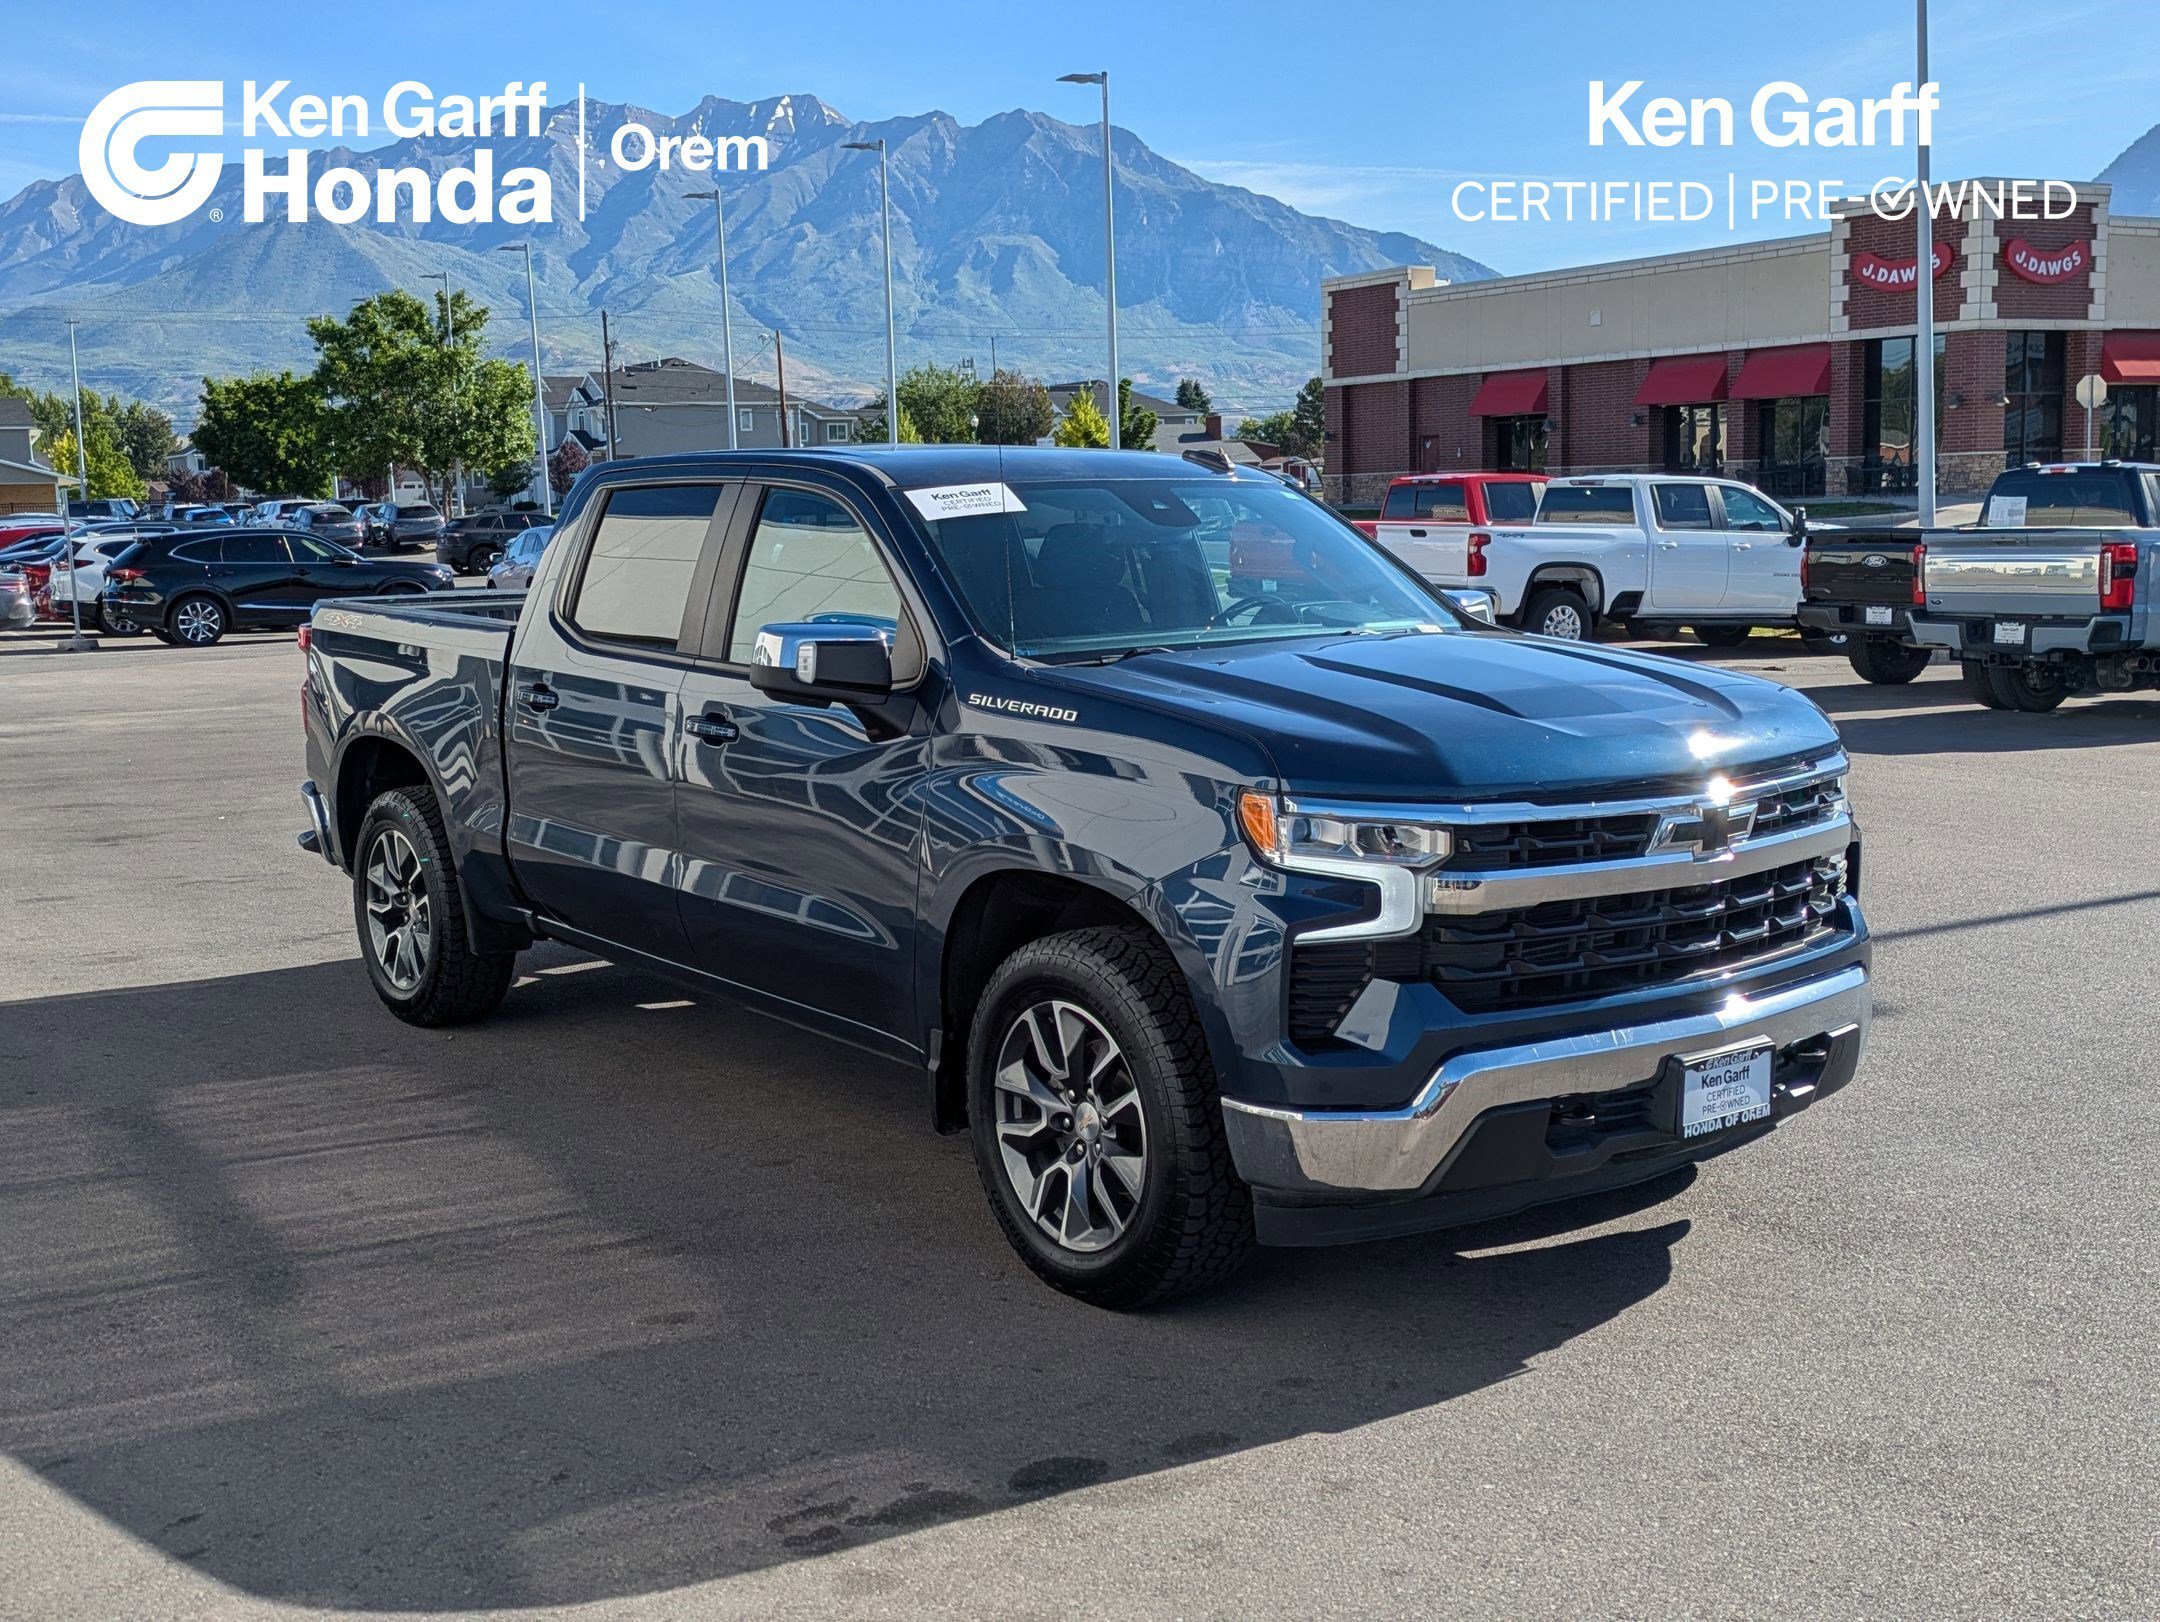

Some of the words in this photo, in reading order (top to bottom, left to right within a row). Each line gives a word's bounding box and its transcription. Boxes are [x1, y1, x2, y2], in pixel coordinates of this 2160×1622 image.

[1862, 253, 1941, 284] J.DAWS
[2015, 250, 2082, 276] J.DAWGS
[931, 491, 959, 501] Ken
[959, 488, 992, 498] Garff
[943, 496, 992, 506] CERTIFIED
[968, 693, 1079, 722] SILVERADO
[1701, 1073, 1723, 1090] Ken
[1723, 1065, 1751, 1084] Garff
[1706, 1084, 1746, 1103] CERTIFIED
[1684, 1120, 1723, 1139] HONDA
[1725, 1113, 1739, 1128] OF
